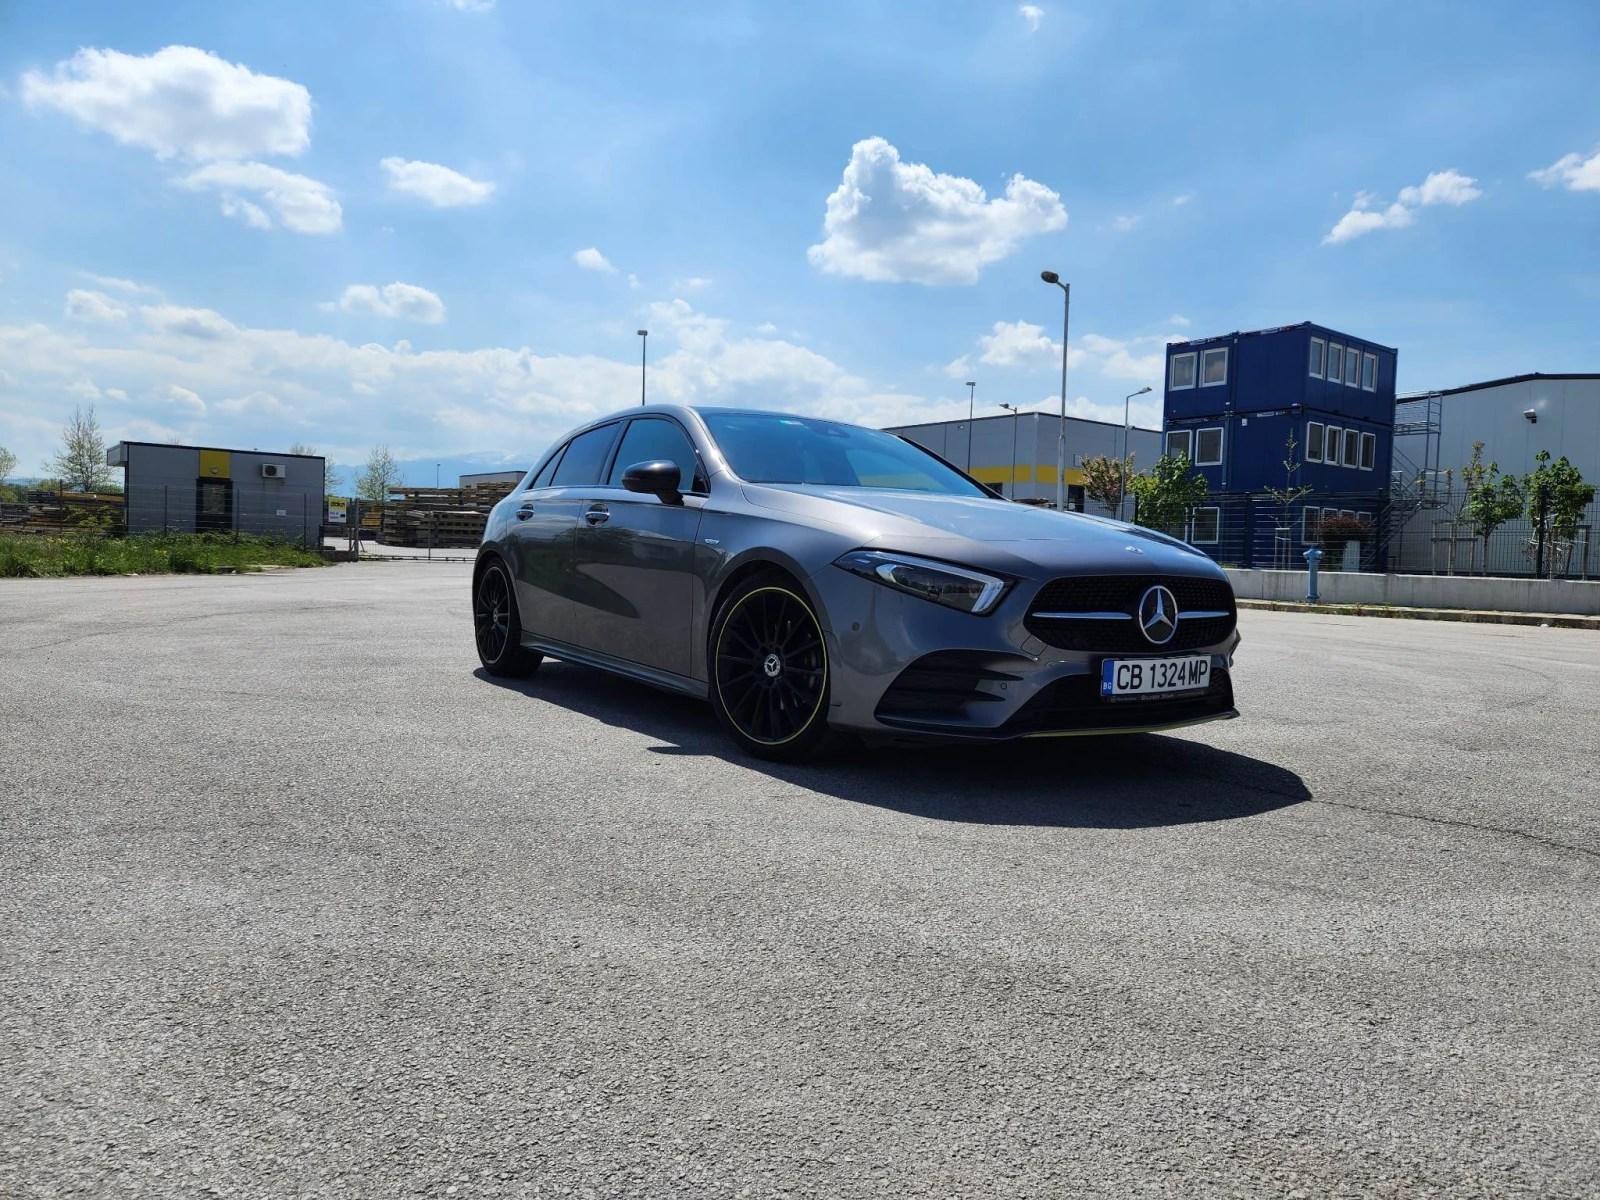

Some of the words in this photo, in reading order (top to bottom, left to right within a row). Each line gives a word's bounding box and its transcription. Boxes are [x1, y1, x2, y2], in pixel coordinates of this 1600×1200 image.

[1116, 664, 1143, 690] CB
[1149, 661, 1186, 689] 1324
[1188, 659, 1208, 685] MP
[1103, 681, 1112, 690] BG
